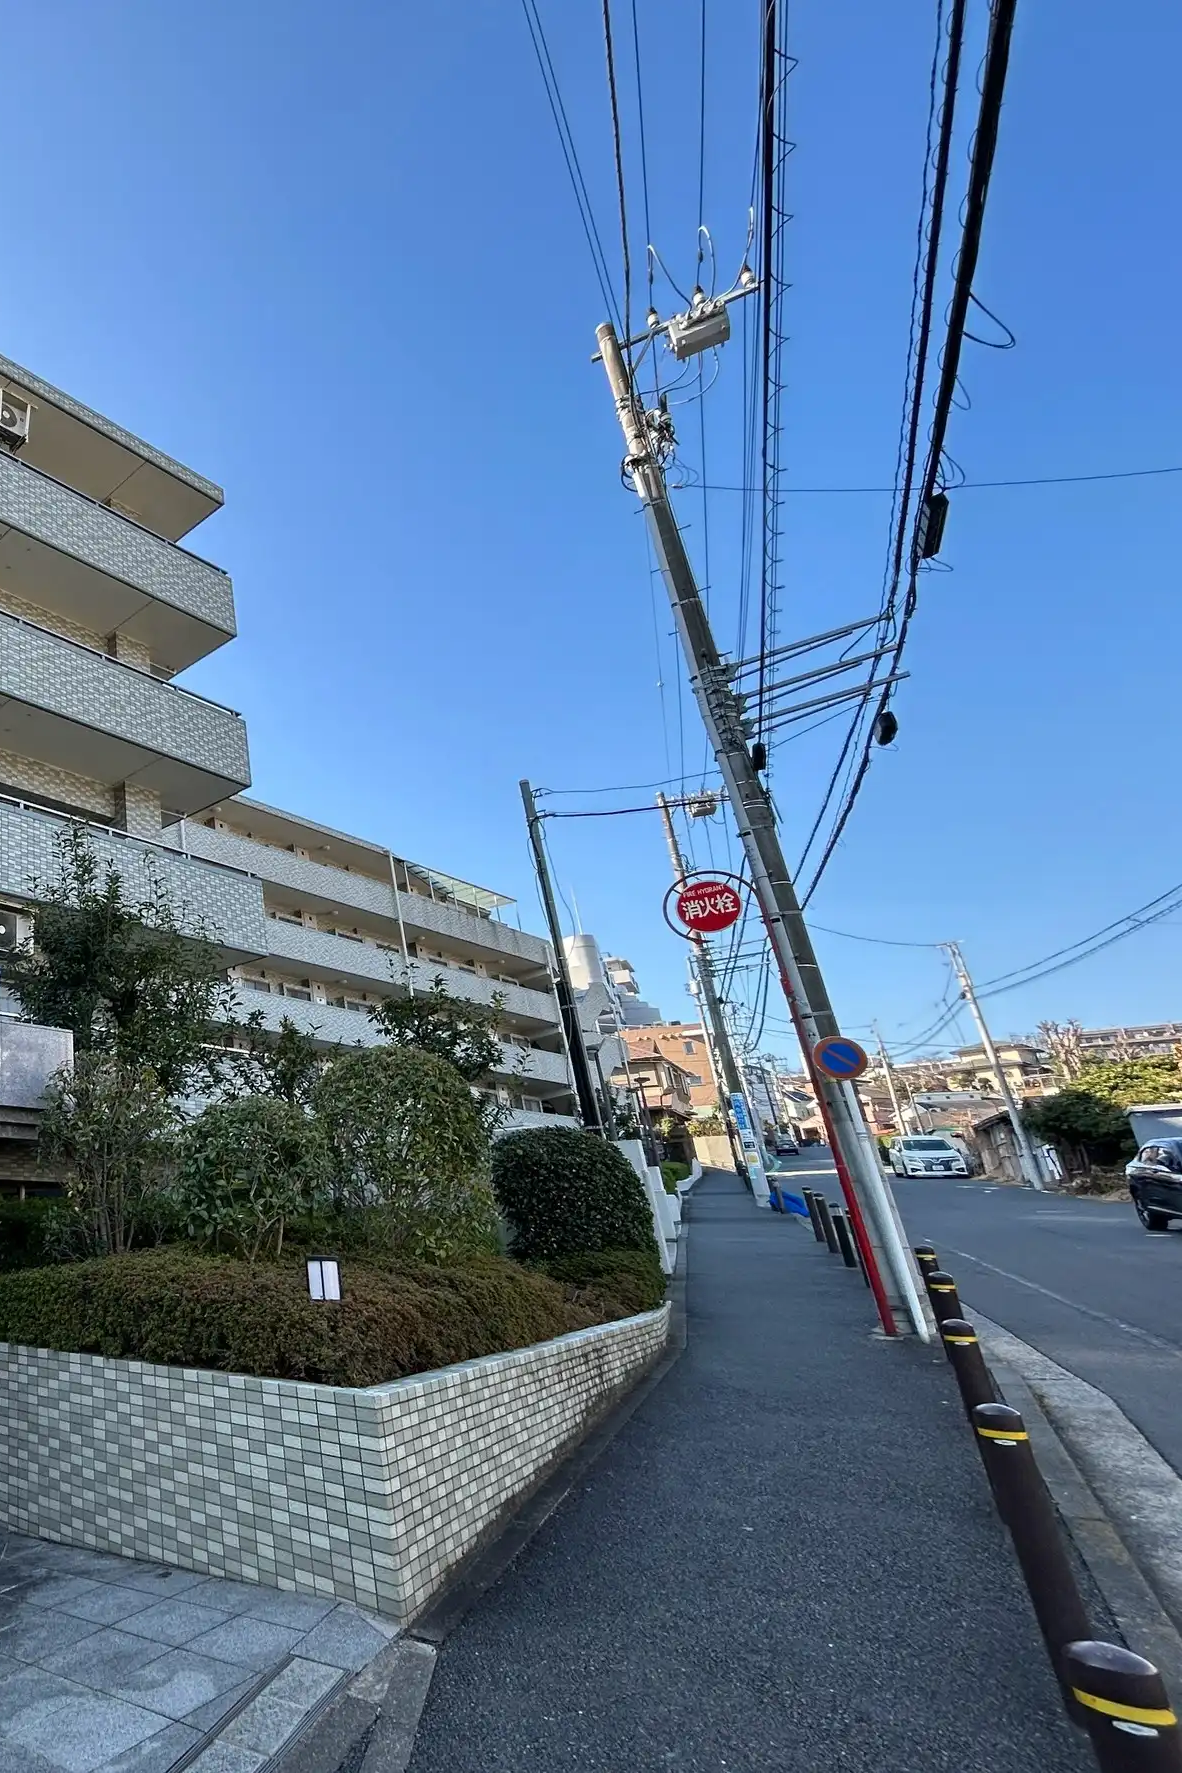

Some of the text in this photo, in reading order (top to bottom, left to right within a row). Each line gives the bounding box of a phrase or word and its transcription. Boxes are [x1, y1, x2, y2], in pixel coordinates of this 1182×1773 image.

[683, 885, 724, 898] FIRE HYDRANT
[681, 892, 737, 920] 消火栓
